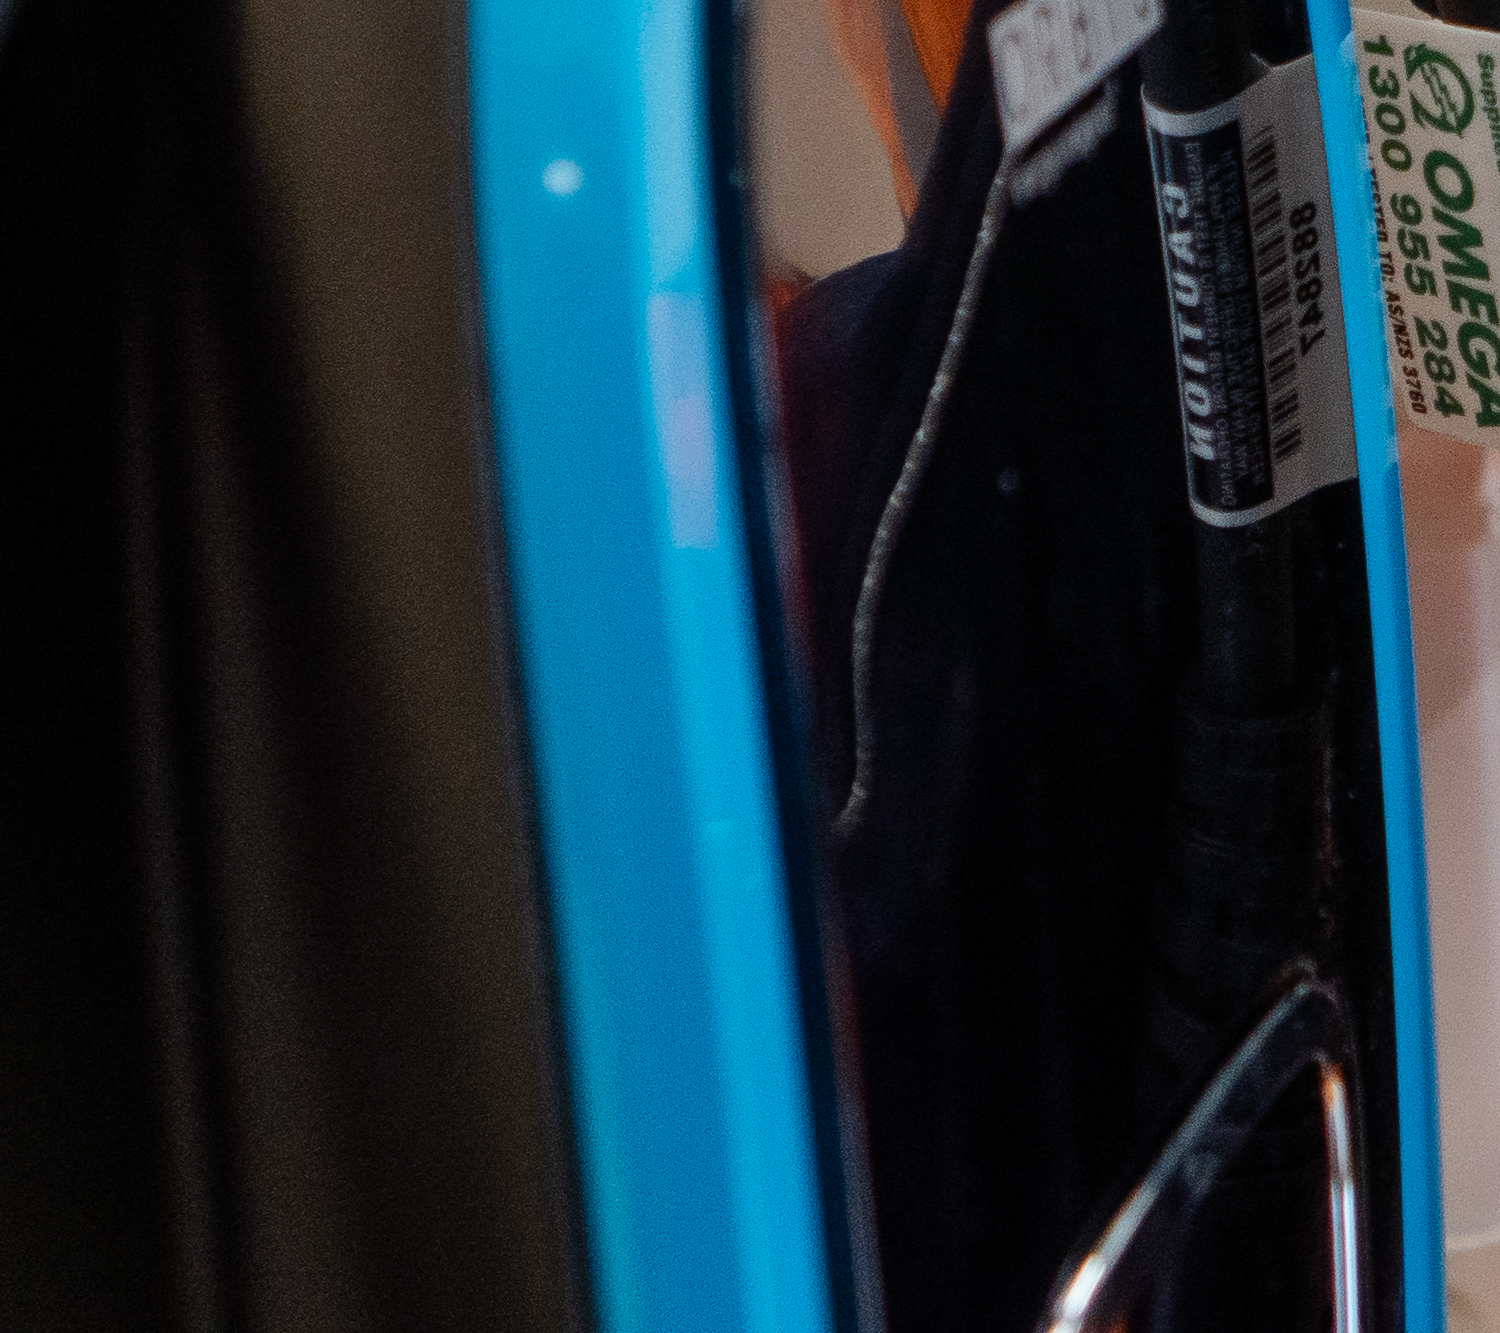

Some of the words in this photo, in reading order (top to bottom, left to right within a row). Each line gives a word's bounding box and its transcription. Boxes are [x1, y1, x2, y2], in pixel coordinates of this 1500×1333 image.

[1363, 34, 1413, 172] 1300
[1389, 193, 1438, 297] 955
[1386, 286, 1413, 361] AS/NZS
[1402, 361, 1429, 417] 3760
[1413, 316, 1465, 418] 284
